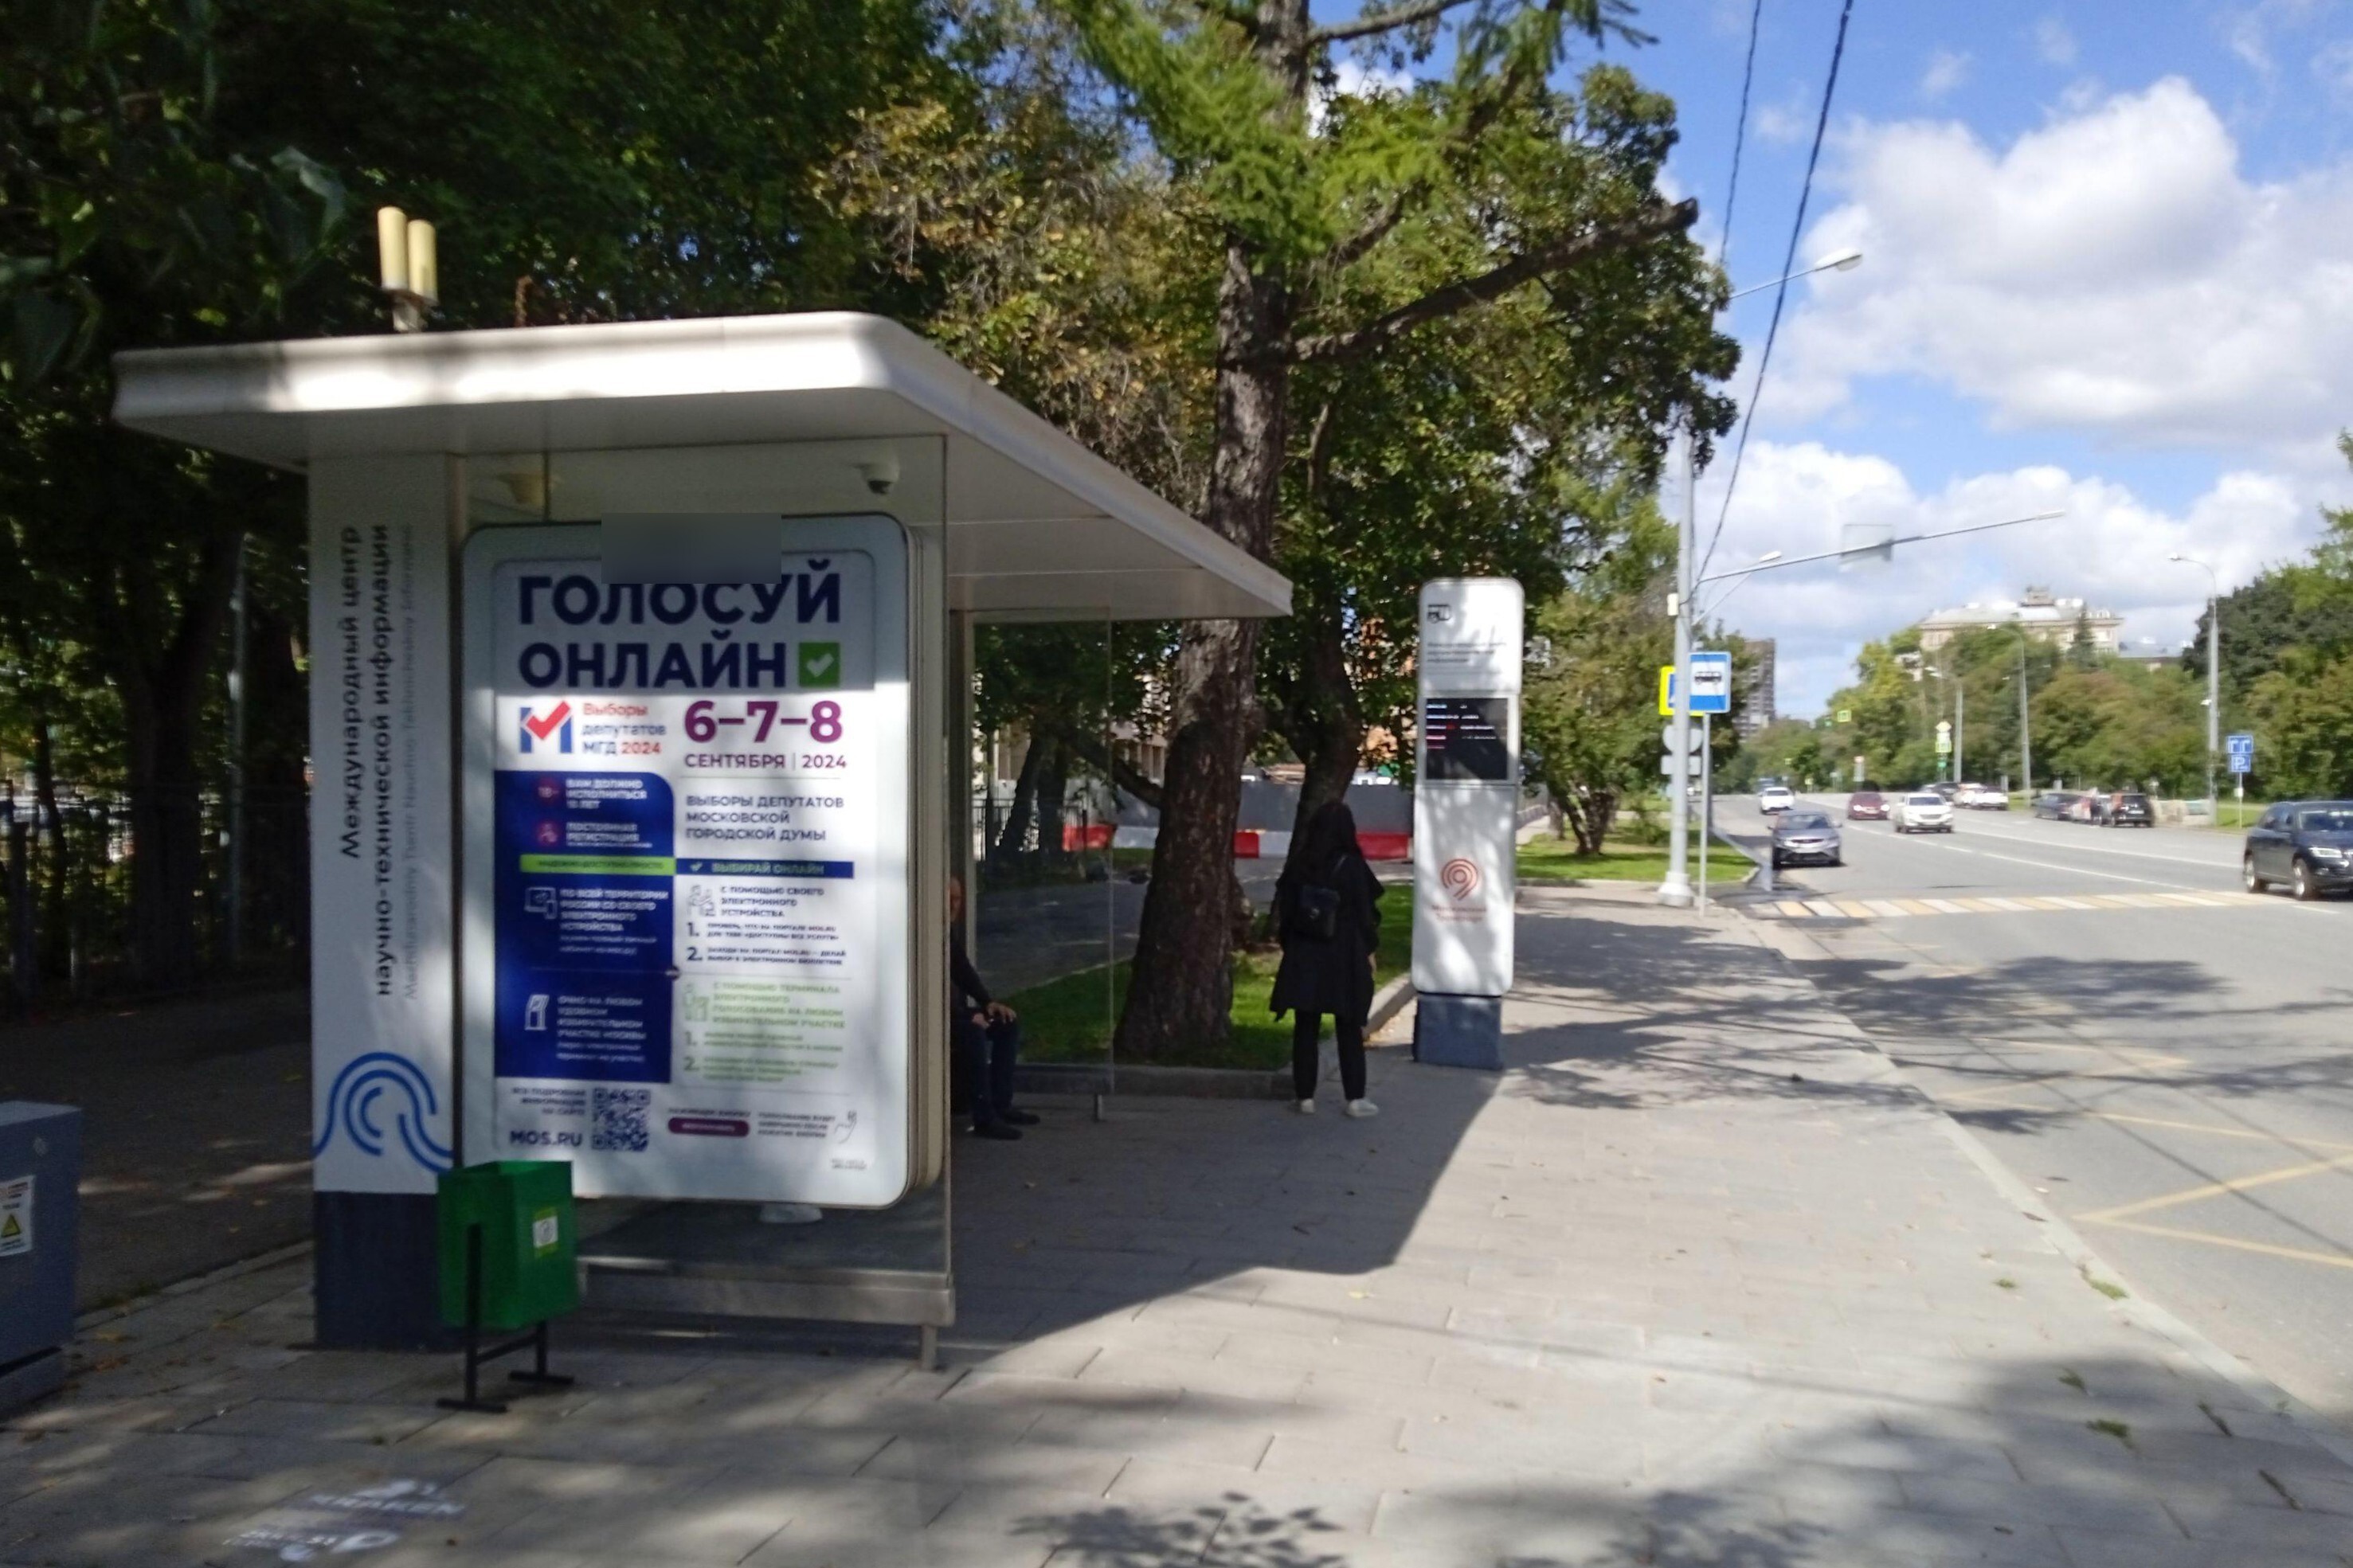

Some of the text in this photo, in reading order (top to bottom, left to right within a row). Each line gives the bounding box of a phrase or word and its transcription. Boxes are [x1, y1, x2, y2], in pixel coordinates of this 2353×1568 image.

[518, 559, 841, 625] ГОЛОСУЙ
[366, 525, 395, 705] информации
[519, 630, 787, 689] ОНЛАЙН
[339, 526, 366, 859] Международный центр
[583, 702, 648, 718] Выборы
[582, 724, 667, 737] депутатов
[583, 741, 662, 755] МГД 2024
[684, 753, 847, 768] СЕНТЯБРЯ 2024
[686, 796, 844, 809] ВЫБОРЫ ДЕПУТАТОВ
[686, 811, 790, 823] МОСКОВСКОЙ
[685, 827, 826, 843] ГОРОДСКОЙ ДУМЫ
[711, 862, 824, 874] ВЫБИРАЙ ОНЛАЙН
[686, 946, 703, 961] 2.
[510, 1130, 583, 1147] MOS.RU
